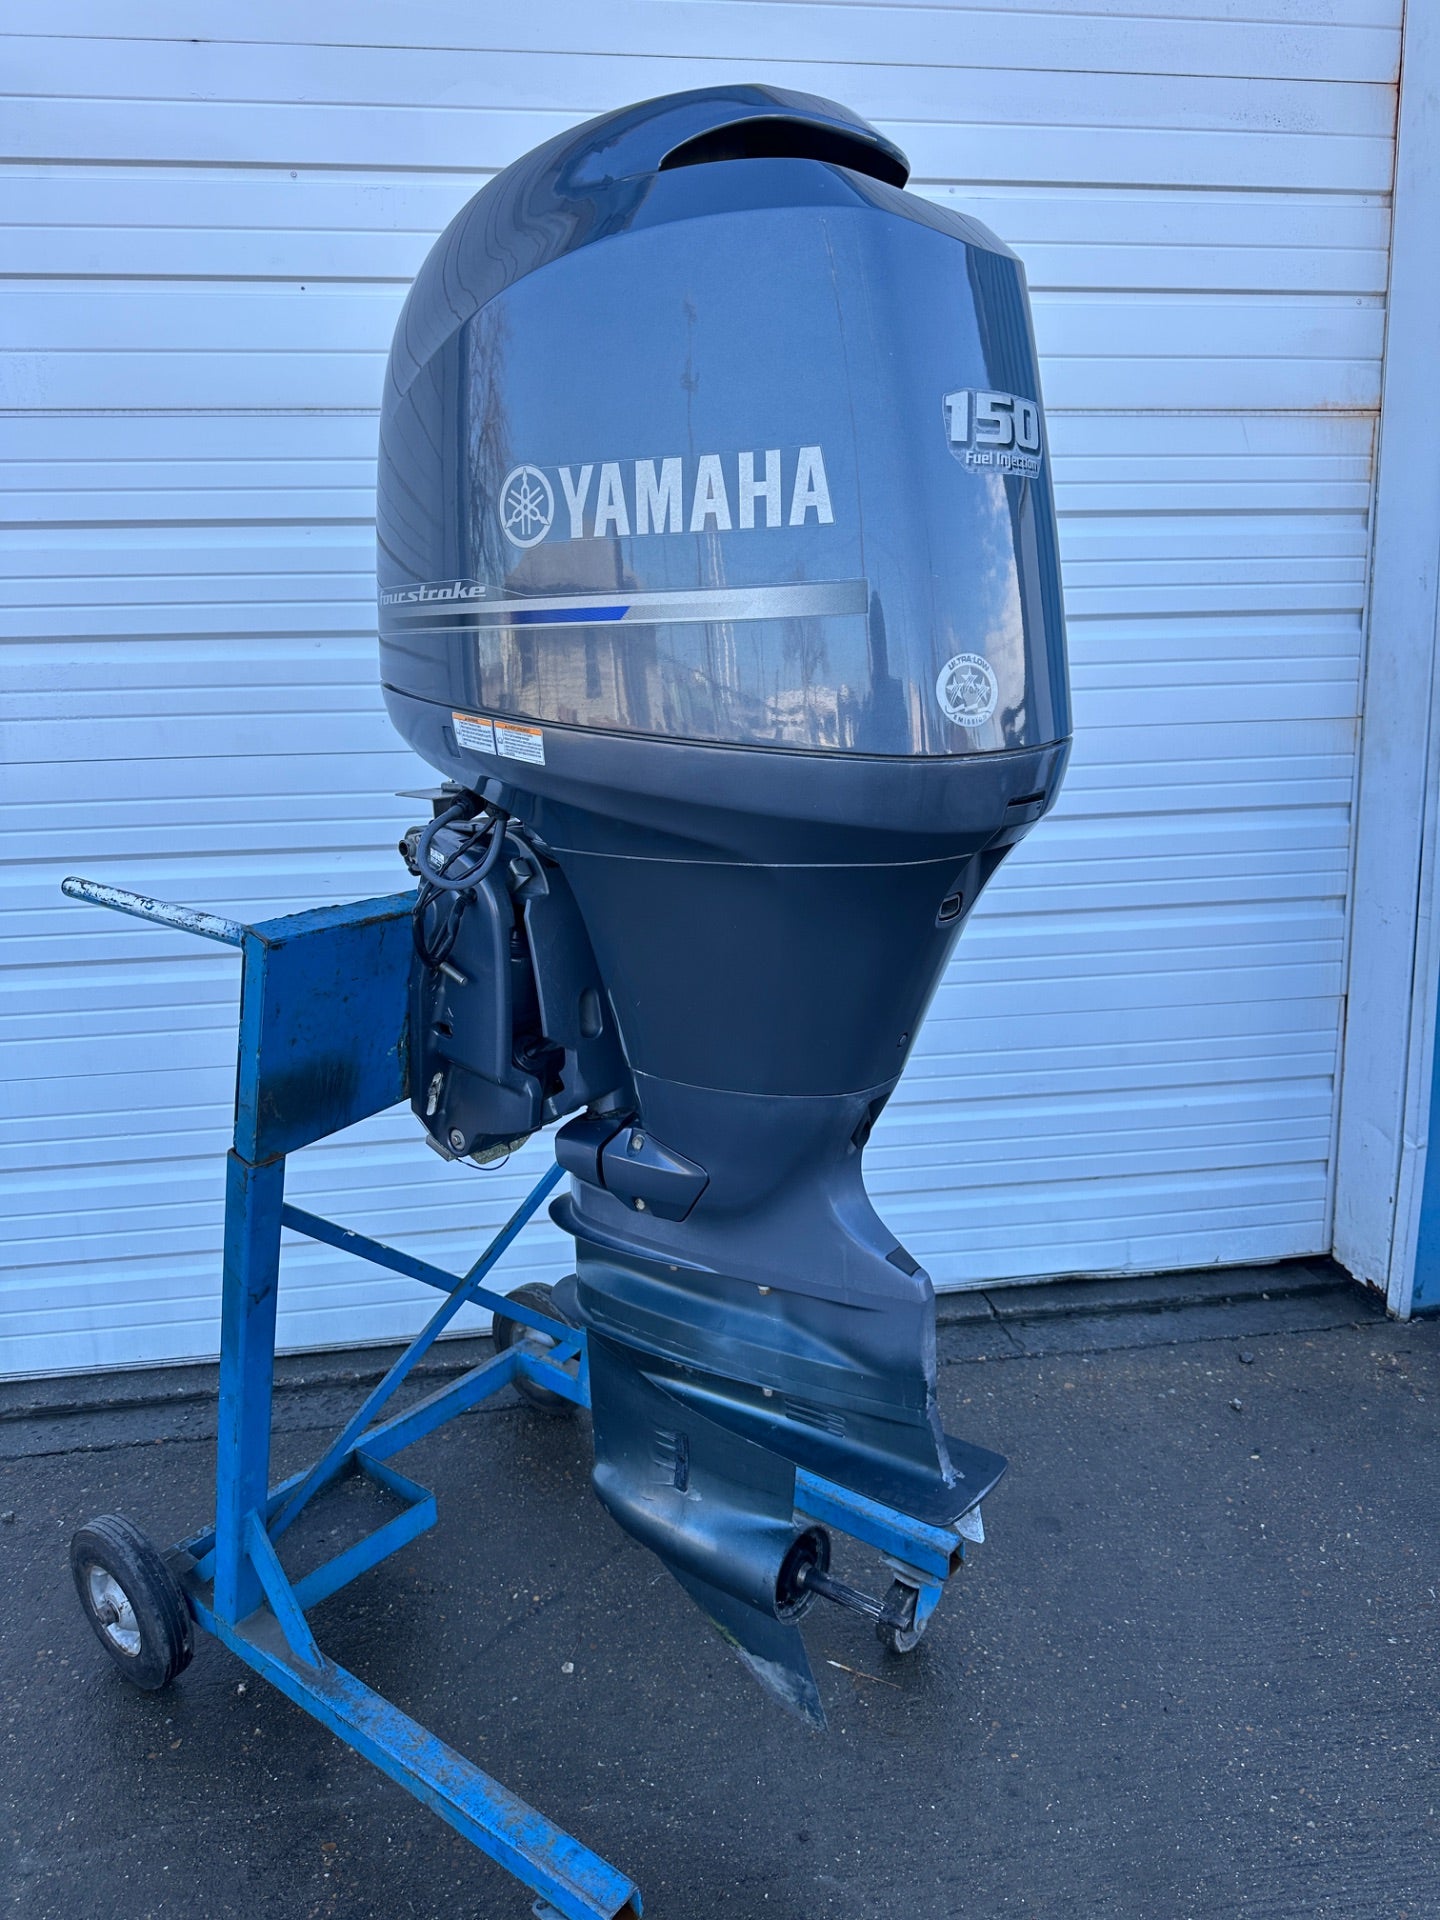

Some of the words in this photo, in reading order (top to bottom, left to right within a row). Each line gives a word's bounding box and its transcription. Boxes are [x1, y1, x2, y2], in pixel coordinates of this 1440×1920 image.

[945, 391, 1040, 451] 150
[965, 450, 993, 465] Fuel
[996, 452, 1038, 473] Injection
[558, 446, 835, 539] YAMAHA
